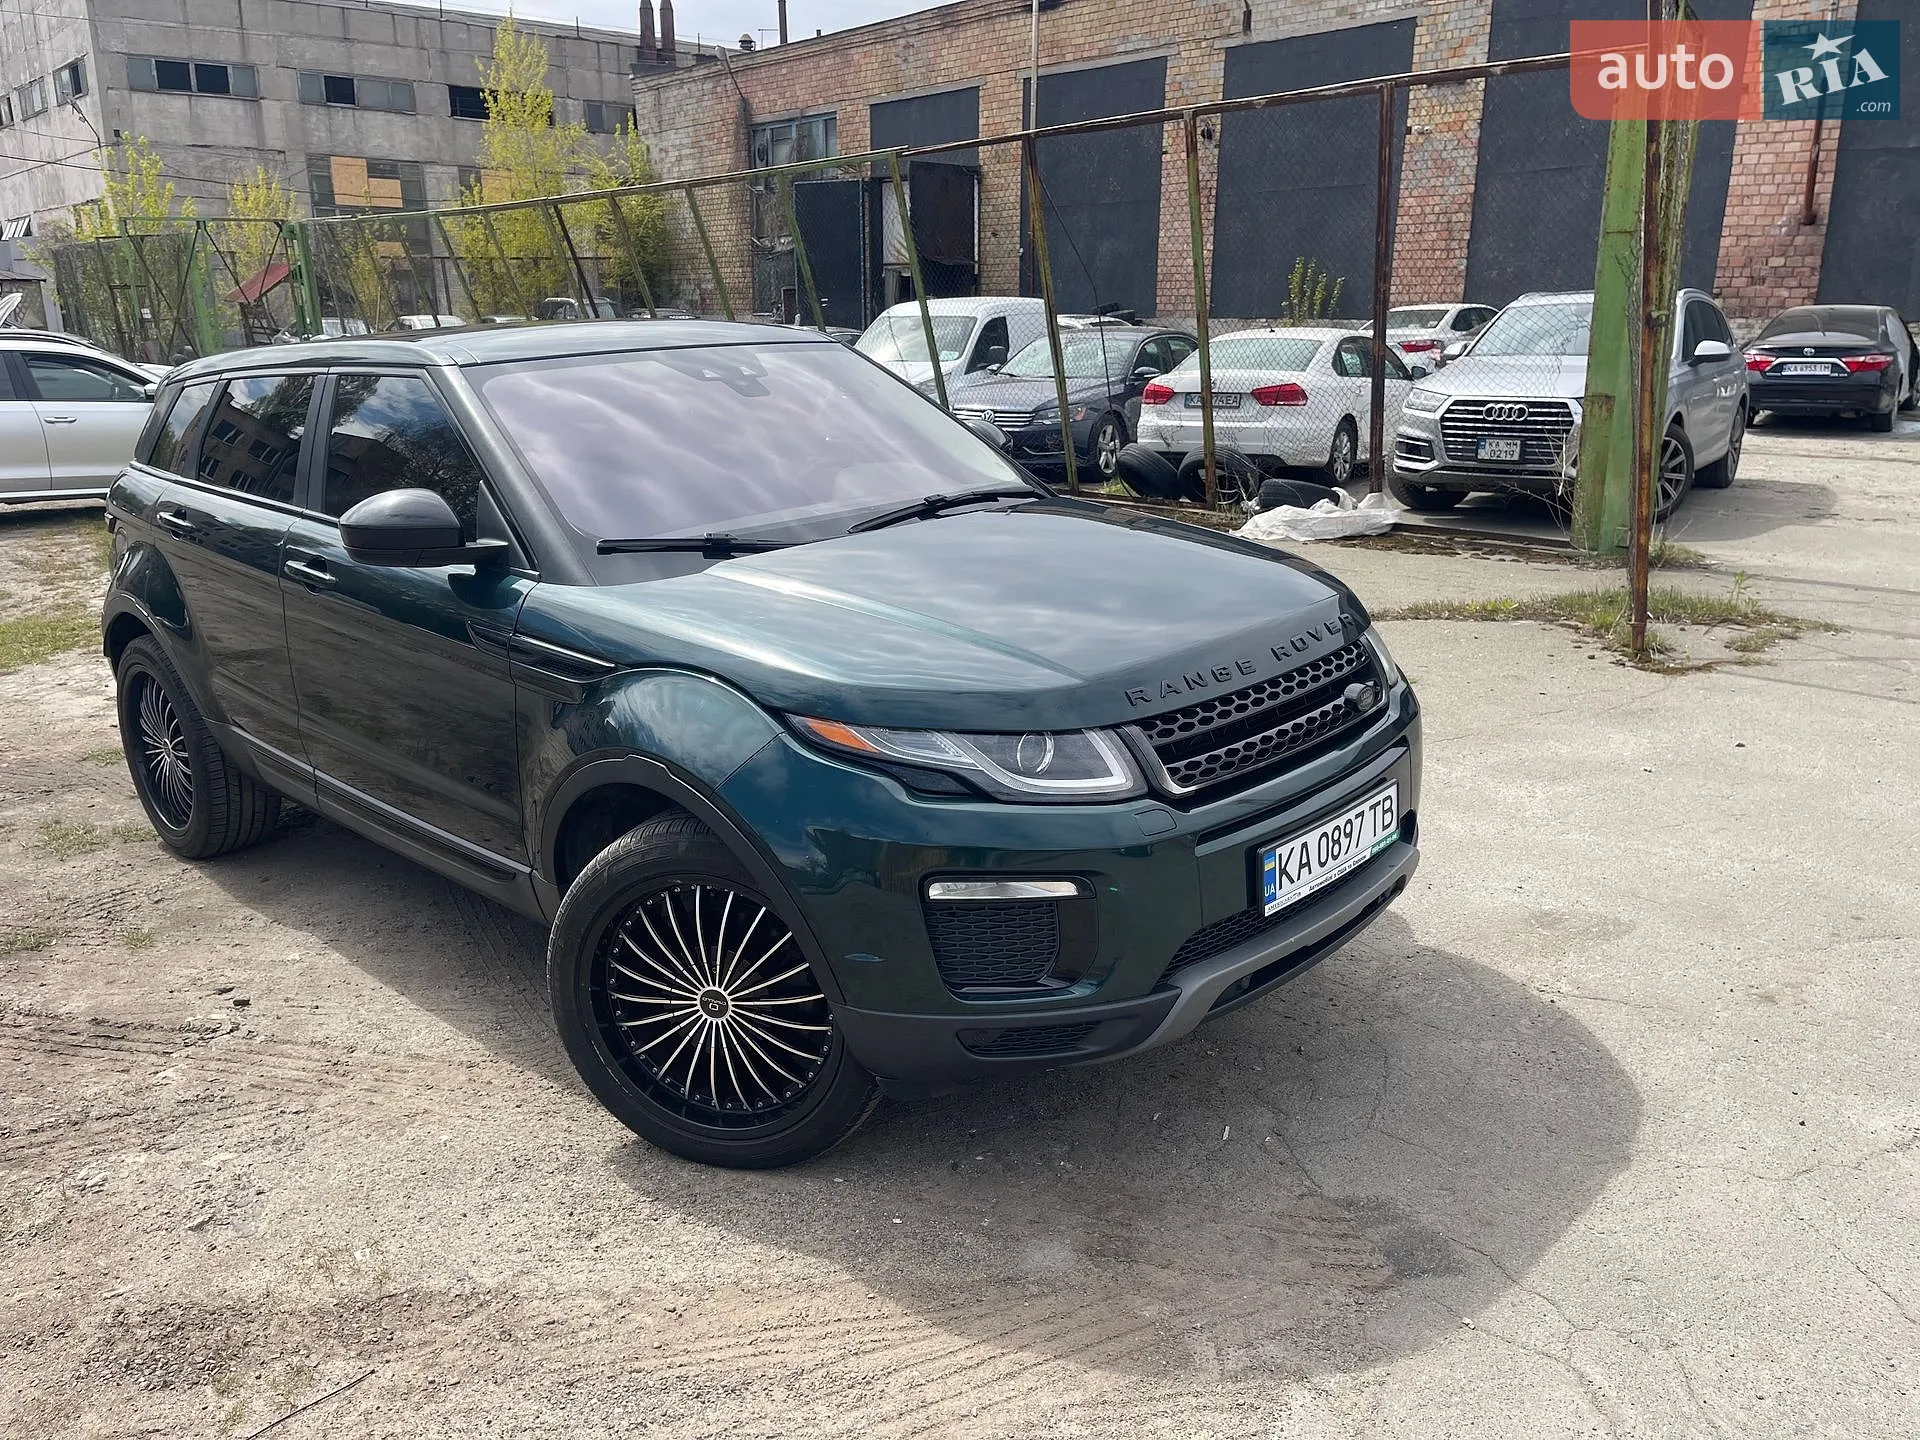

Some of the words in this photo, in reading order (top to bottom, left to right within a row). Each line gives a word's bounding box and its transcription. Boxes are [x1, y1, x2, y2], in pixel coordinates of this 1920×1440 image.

[1490, 449, 1515, 459] 0219
[1124, 657, 1257, 707] RANGE
[1270, 613, 1356, 662] ROVER
[1278, 841, 1312, 891] KA
[1317, 809, 1365, 868] 0897
[1368, 794, 1394, 837] TB
[1264, 882, 1276, 897] UA
